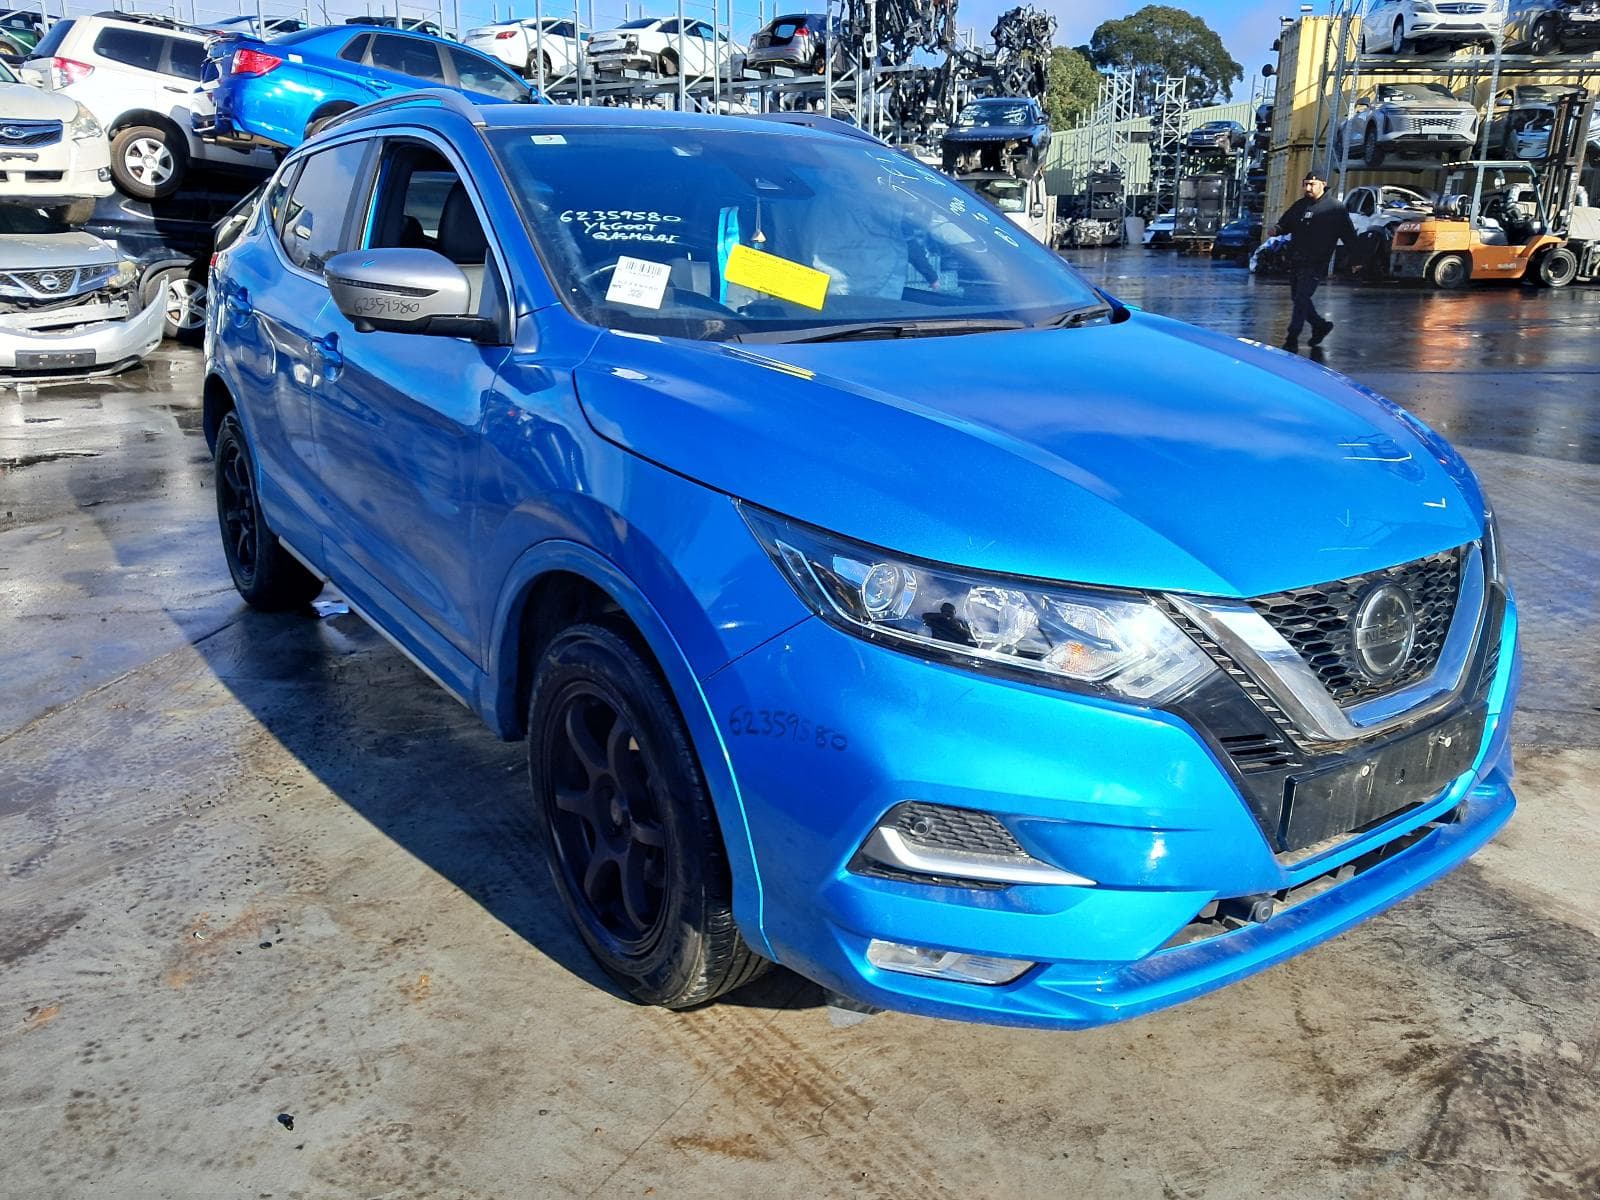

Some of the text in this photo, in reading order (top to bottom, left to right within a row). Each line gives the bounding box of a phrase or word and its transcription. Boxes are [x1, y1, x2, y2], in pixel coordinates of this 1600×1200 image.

[559, 209, 682, 222] 62359580
[353, 297, 420, 314] 62359580
[729, 705, 848, 751] 62359580
